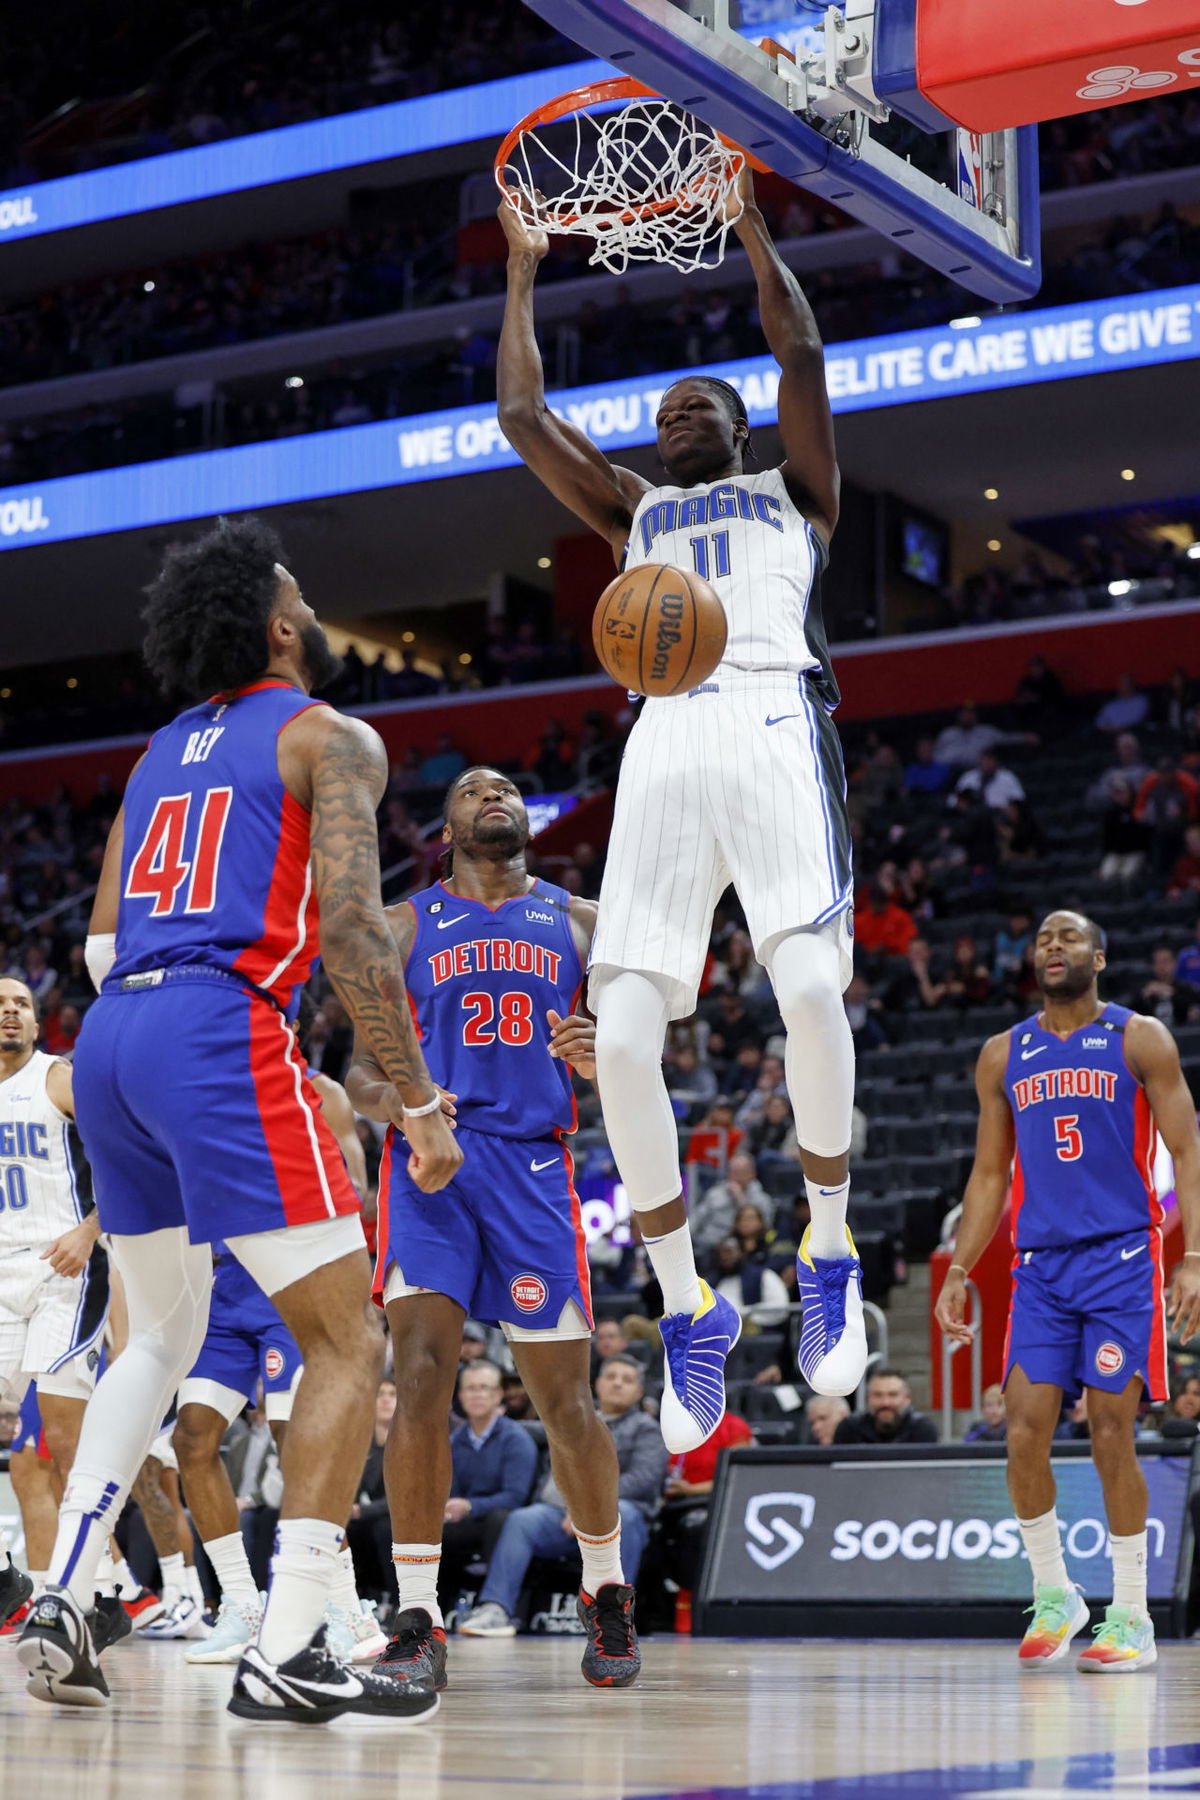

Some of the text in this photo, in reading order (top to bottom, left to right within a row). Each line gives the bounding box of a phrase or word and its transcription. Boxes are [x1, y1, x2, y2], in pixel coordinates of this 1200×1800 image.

[399, 425, 452, 468] WE
[566, 394, 641, 437] YOU
[824, 347, 924, 397] ELITE
[928, 329, 1027, 381] CARE
[1031, 318, 1094, 365] WE
[1099, 303, 1192, 354] GIVE
[0, 496, 50, 535] OU.
[640, 484, 783, 557] MAGIC
[690, 530, 731, 581] 11
[650, 593, 684, 680] Wilson
[181, 727, 225, 765] BEY
[124, 786, 233, 917] 41
[430, 902, 441, 913] 6
[525, 909, 555, 923] UWM
[428, 939, 562, 986] DETROIT
[461, 991, 533, 1046] 28
[1021, 1033, 1032, 1045] 6
[1082, 1037, 1107, 1047] UWM
[1012, 1068, 1118, 1112] DETROIT
[1054, 1114, 1083, 1162] 5
